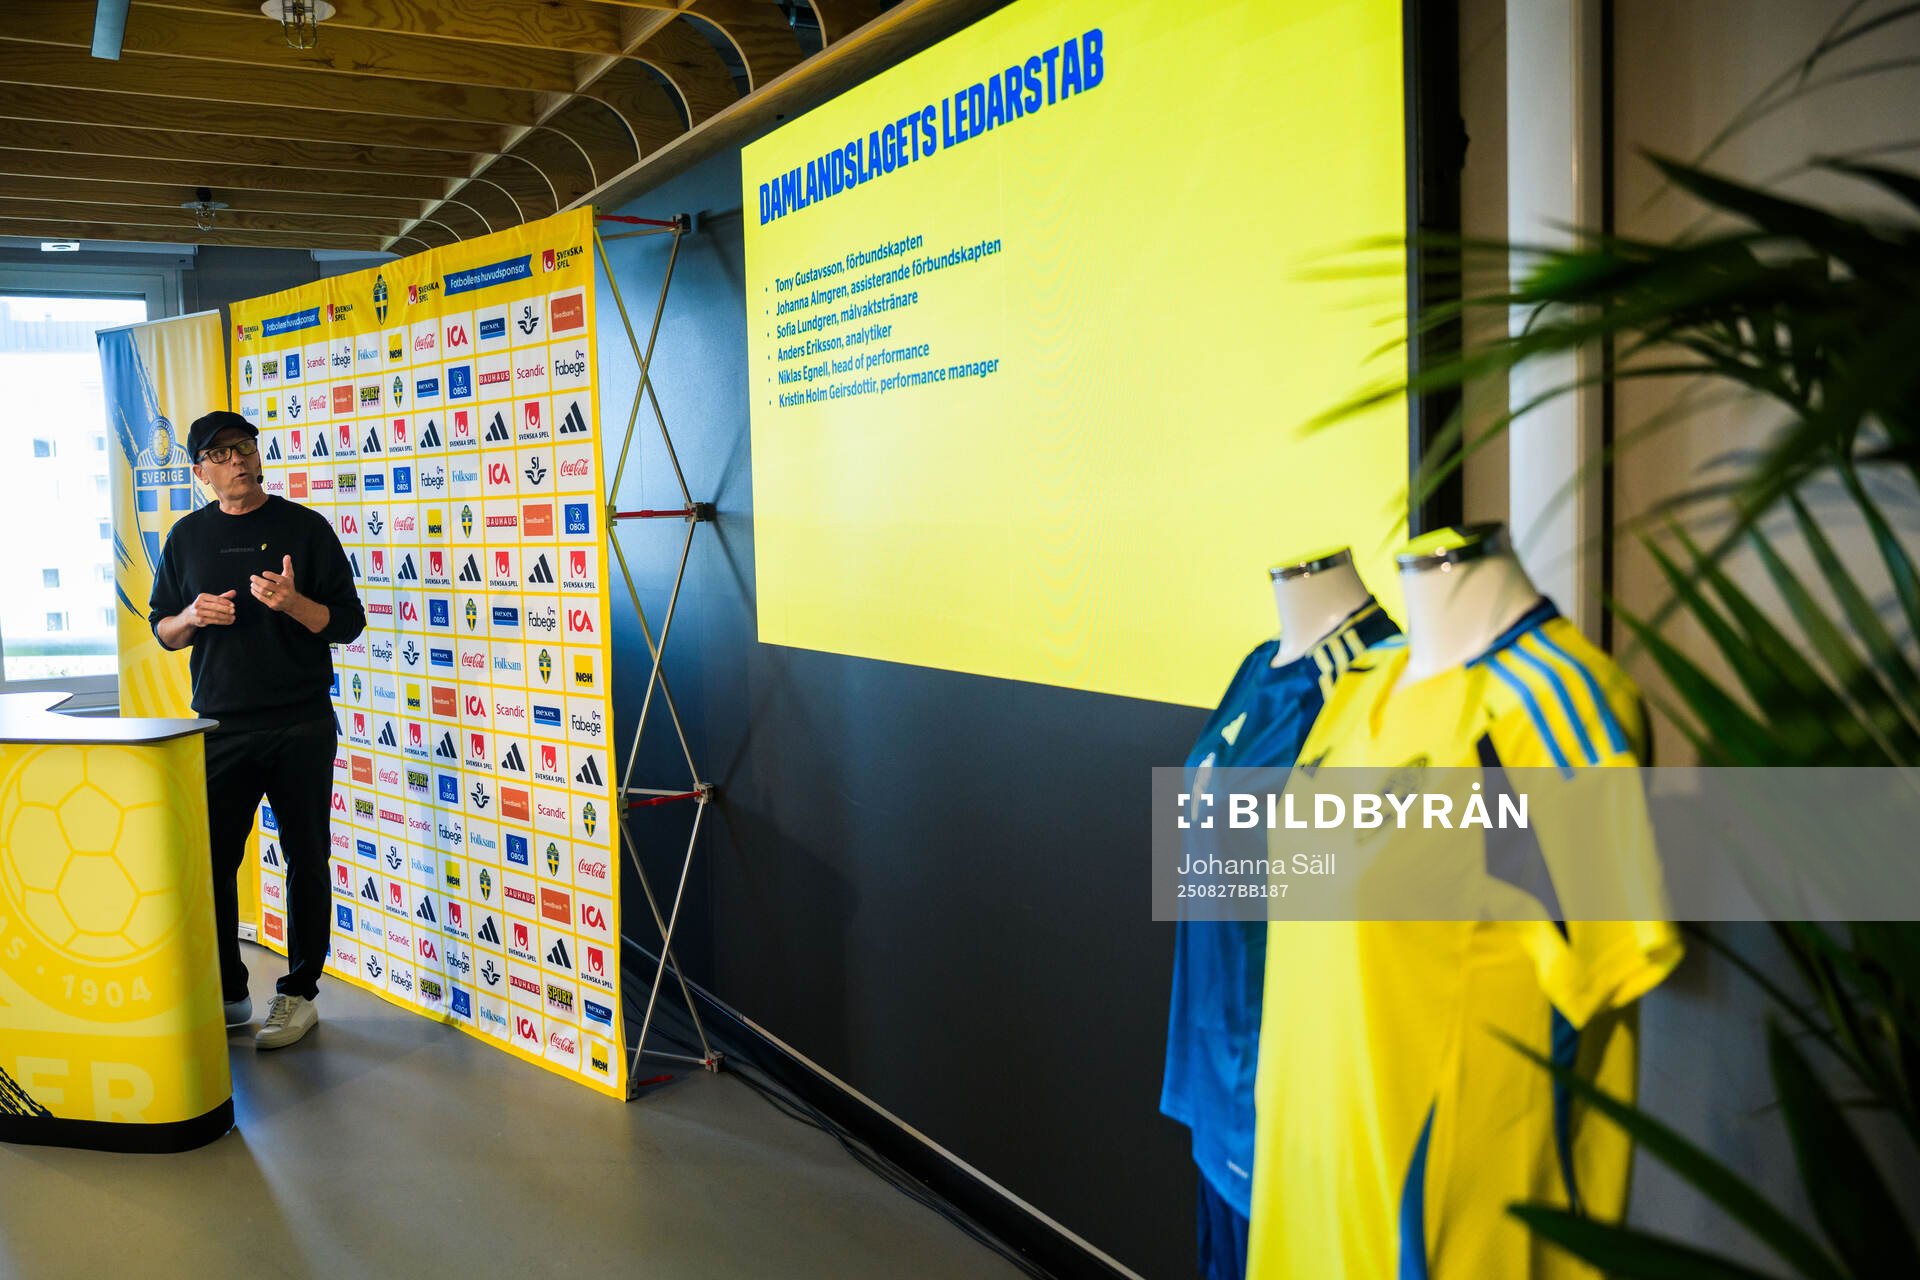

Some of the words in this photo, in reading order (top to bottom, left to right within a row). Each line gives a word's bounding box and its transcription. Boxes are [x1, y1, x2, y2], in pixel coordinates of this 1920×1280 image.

[759, 104, 938, 227] DAMLANDSLAGETS
[942, 28, 1104, 150] LEDARSTAB
[556, 246, 583, 261] SVENSKA
[557, 259, 570, 270] SPEL
[775, 275, 793, 293] Tony
[795, 261, 845, 286] Gustavsson,
[846, 234, 923, 271] förbundskapten
[450, 273, 481, 288] Fotbollens
[480, 264, 525, 283] huvudsponsor
[776, 297, 809, 316] Johanna
[811, 285, 849, 306] Almgren,
[851, 264, 910, 294] assisterande
[912, 239, 1001, 275] förbundskapten
[418, 282, 439, 294] SVENSKA
[335, 304, 353, 313] SVENSKA
[524, 306, 532, 319] SJ
[777, 322, 796, 339] Sofia
[797, 312, 839, 334] Lundgren,
[841, 290, 918, 322] målvaktstränare
[335, 314, 346, 322] SPEL
[447, 325, 468, 348] ICA
[777, 345, 805, 362] Anders
[806, 336, 844, 356] Eriksson,
[846, 323, 892, 347] analytiker
[332, 354, 351, 368] Fabege
[358, 349, 378, 360] Folksam
[307, 357, 326, 369] Scandic
[555, 360, 585, 377] Fabege
[778, 367, 801, 385] Niklas
[803, 362, 831, 381] Egnell,
[831, 356, 853, 374] head
[855, 354, 864, 369] of
[866, 342, 929, 368] performance
[479, 372, 510, 384] BAUHAUS
[516, 365, 544, 379] Scandic
[779, 391, 804, 408] Kristin
[806, 385, 828, 404] Holm
[829, 377, 879, 399] Geirsdottir,
[880, 368, 946, 393] performance
[949, 358, 999, 380] manager
[360, 386, 380, 402] SPORT
[453, 387, 467, 396] OBOS
[291, 395, 297, 406] SJ
[539, 431, 549, 439] SPEL
[532, 457, 539, 469] SJ
[142, 470, 184, 484] SVERIGE
[421, 473, 444, 489] Fabege
[452, 471, 478, 482] Folksam
[488, 463, 510, 485] ICA
[267, 482, 284, 491] Scandic
[341, 515, 358, 534] ICA
[372, 511, 378, 523] SJ
[486, 516, 517, 527] BAUHAUS
[570, 523, 585, 531] OBOS
[368, 604, 392, 614] BAUHAUS
[400, 601, 418, 621] ICA
[433, 616, 446, 624] OBOS
[528, 612, 556, 631] Fabege
[568, 609, 593, 632] ICA
[372, 644, 392, 662] Fabege
[408, 640, 414, 652] SJ
[494, 657, 521, 671] Folksam
[374, 686, 395, 699] Folksam
[466, 695, 486, 717] ICA
[496, 703, 524, 718] Scandic
[572, 715, 601, 736] Fabege
[408, 771, 428, 787] SPORT
[535, 772, 553, 781] SVENSKA
[554, 776, 566, 784] SPEL
[477, 782, 483, 794] SJ
[442, 792, 455, 800] OBOS
[380, 810, 404, 824] BAUHAUS
[538, 804, 566, 820] Scandic
[409, 818, 431, 832] Scandic
[439, 824, 462, 845] Fabege
[470, 832, 496, 849] Folksam
[391, 846, 397, 858] SJ
[511, 852, 524, 862] OBOS
[411, 859, 434, 874] Folksam
[504, 888, 535, 903] BAUHAUS
[582, 903, 606, 931] ICA
[444, 926, 459, 936] SVENSKA
[388, 931, 410, 948] Scandic
[337, 949, 357, 965] Scandic
[419, 938, 438, 962] ICA
[509, 948, 526, 958] SVENSKA
[527, 954, 536, 962] SPEL
[446, 952, 470, 973] Fabege
[487, 960, 493, 972] SJ
[392, 970, 412, 992] Fabege
[510, 976, 540, 995] BAUHAUS
[581, 972, 601, 985] SVENSKA
[602, 980, 612, 989] SPEL
[62, 974, 152, 1008] 1904
[548, 984, 573, 1009] SPORT
[480, 1006, 506, 1026] Folksam
[517, 1016, 538, 1043] ICA
